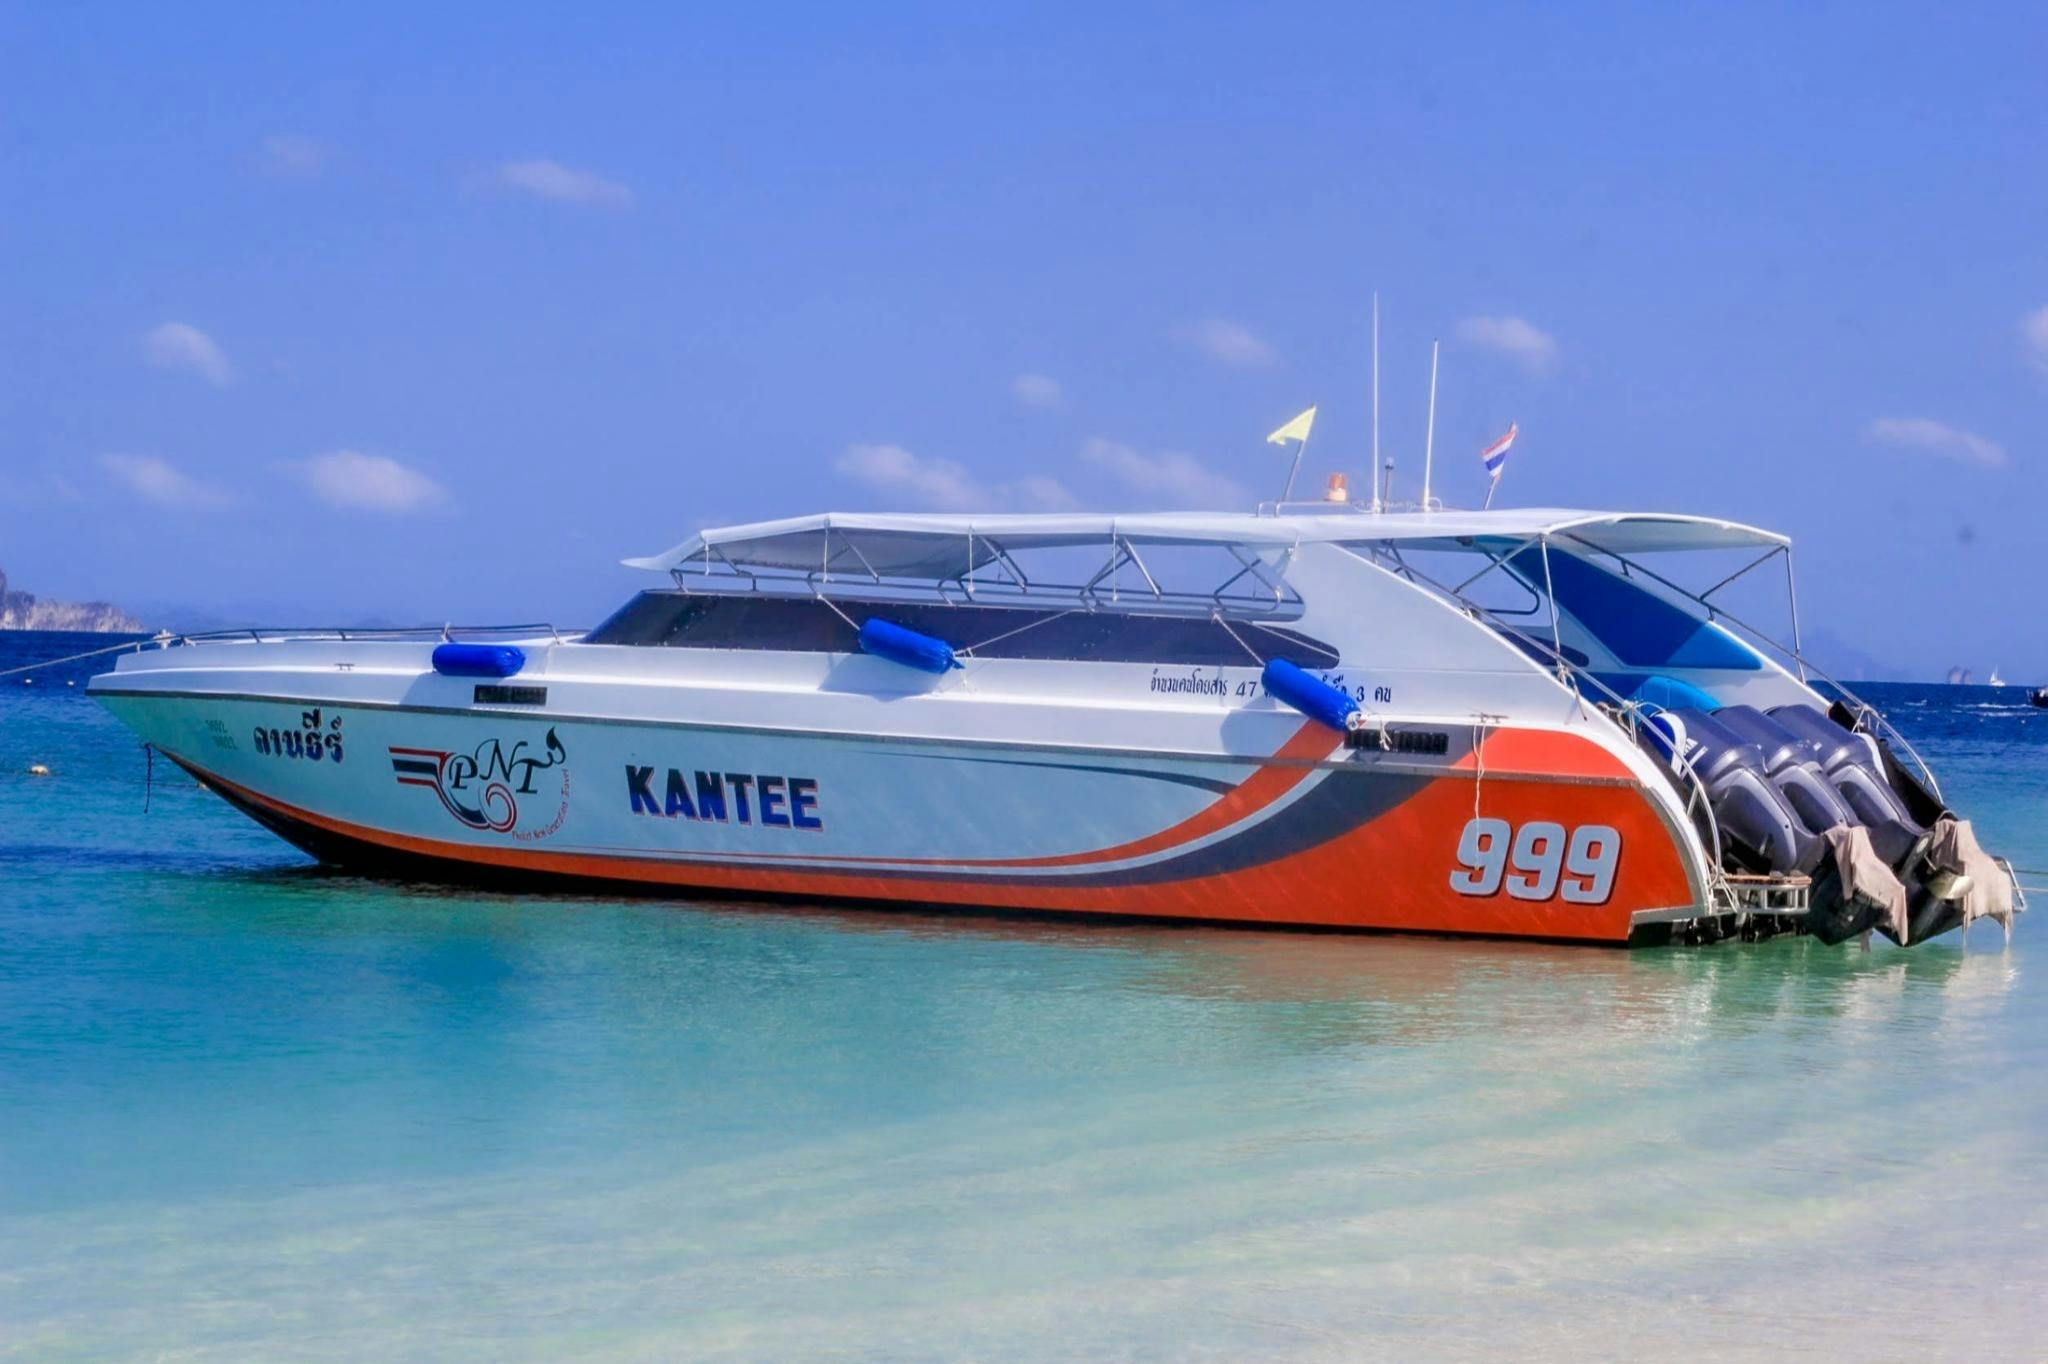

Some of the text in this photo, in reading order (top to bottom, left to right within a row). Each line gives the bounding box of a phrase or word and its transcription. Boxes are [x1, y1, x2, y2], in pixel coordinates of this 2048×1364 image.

[1235, 681, 1257, 698] 47
[1356, 685, 1392, 703] 3 คน
[449, 727, 566, 794] PNT
[625, 765, 824, 832] KANTEE
[1449, 818, 1623, 907] 999
